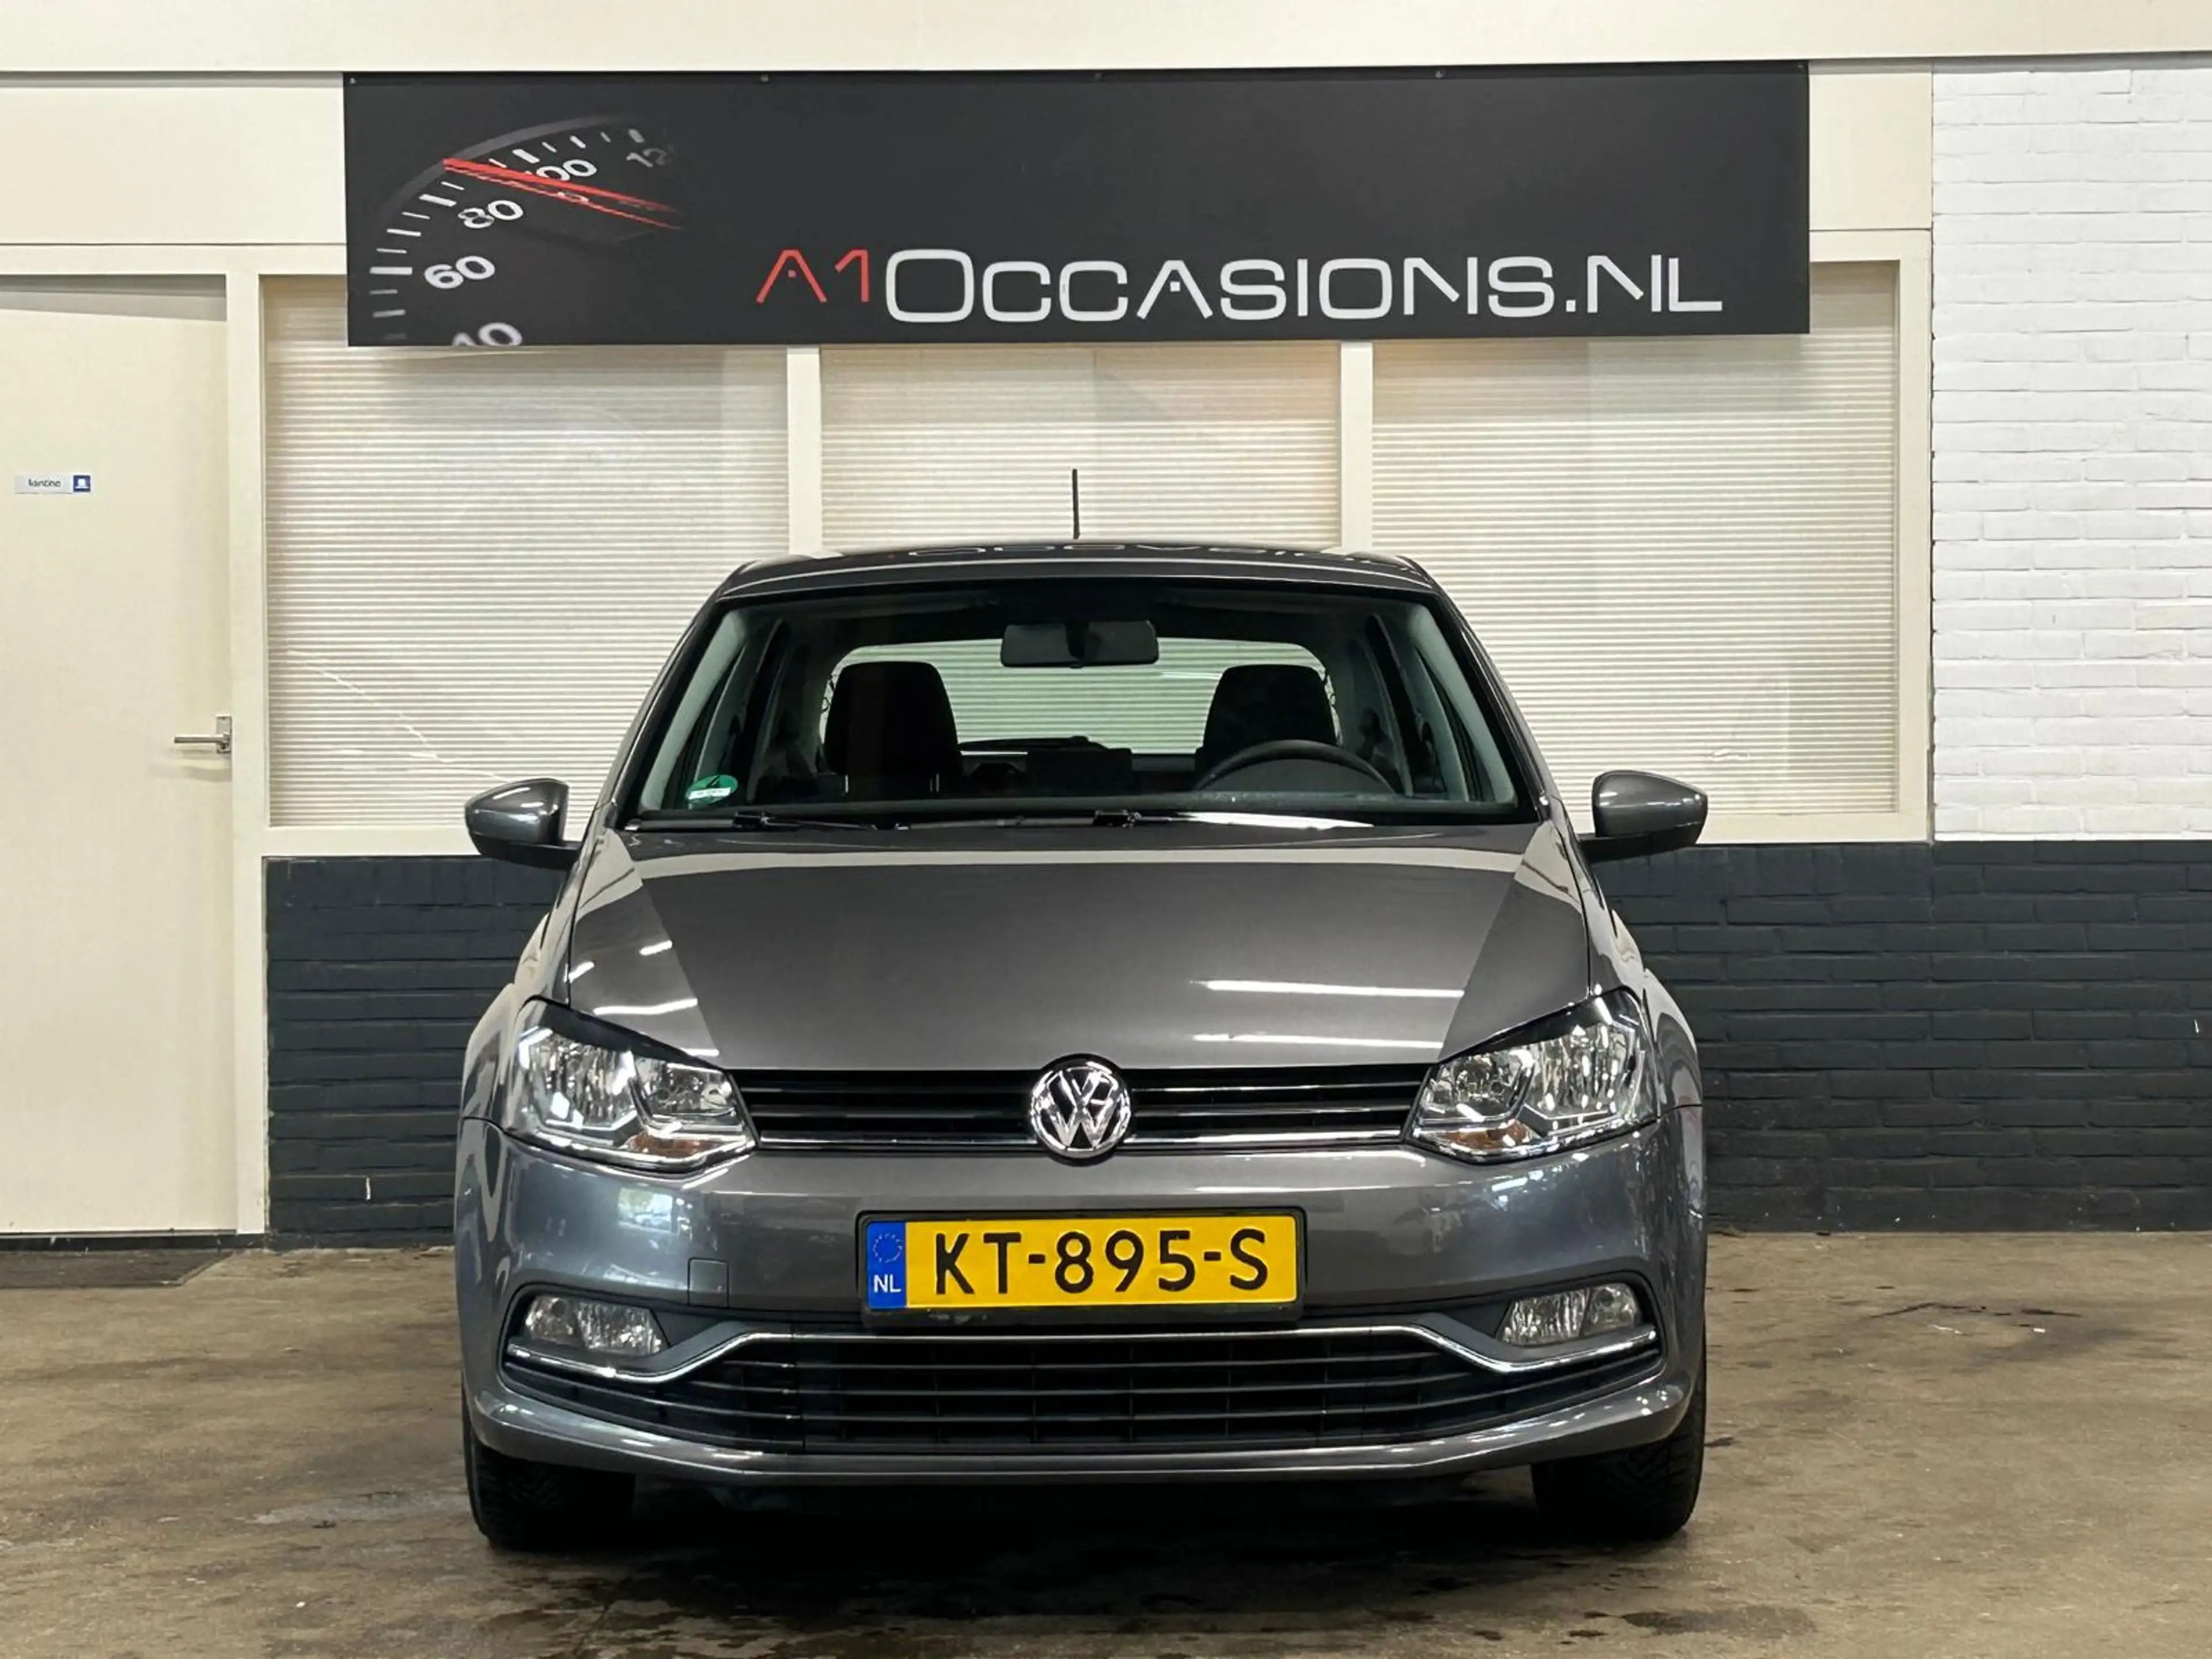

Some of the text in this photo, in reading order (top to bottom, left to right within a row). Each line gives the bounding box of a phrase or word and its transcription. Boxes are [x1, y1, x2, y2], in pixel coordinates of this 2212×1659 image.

[458, 200, 523, 229] 80
[425, 256, 495, 289] 60
[935, 1229, 1268, 1294] KT-895-S
[873, 1274, 902, 1294] NL
